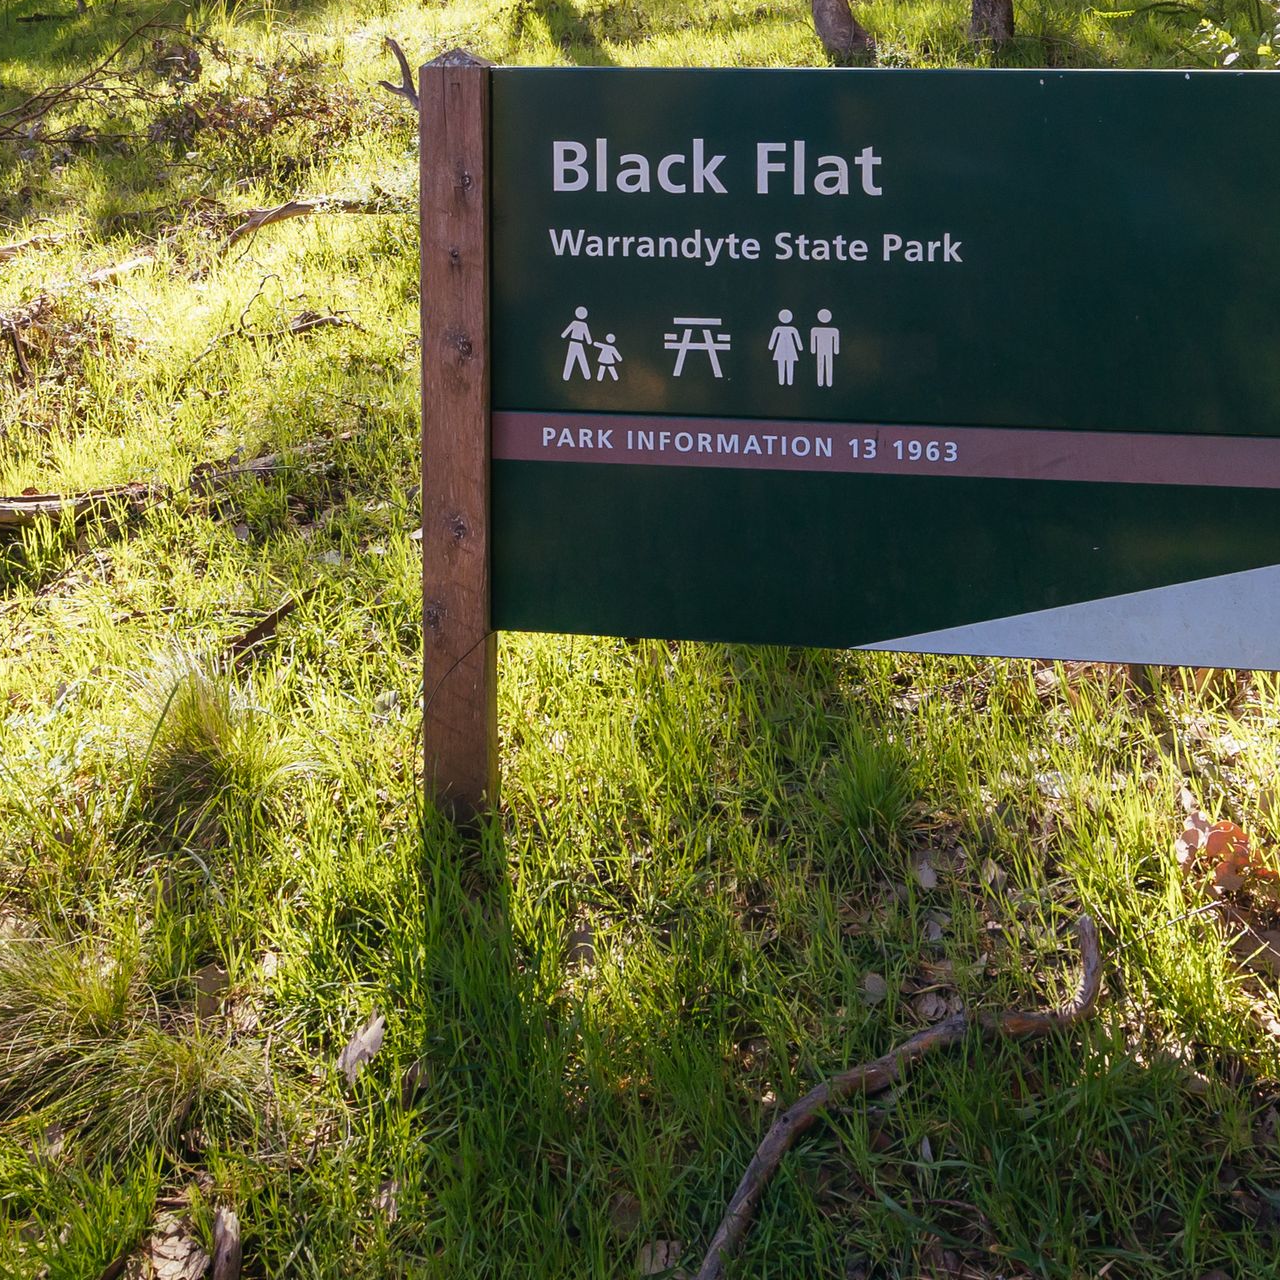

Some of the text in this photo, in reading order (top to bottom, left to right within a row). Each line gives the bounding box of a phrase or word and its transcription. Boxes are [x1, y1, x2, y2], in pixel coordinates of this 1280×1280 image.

[552, 137, 883, 196] Black Flat
[548, 228, 963, 267] Warrandyte State Park
[542, 426, 959, 462] PARK INFORMATION 13 1963
